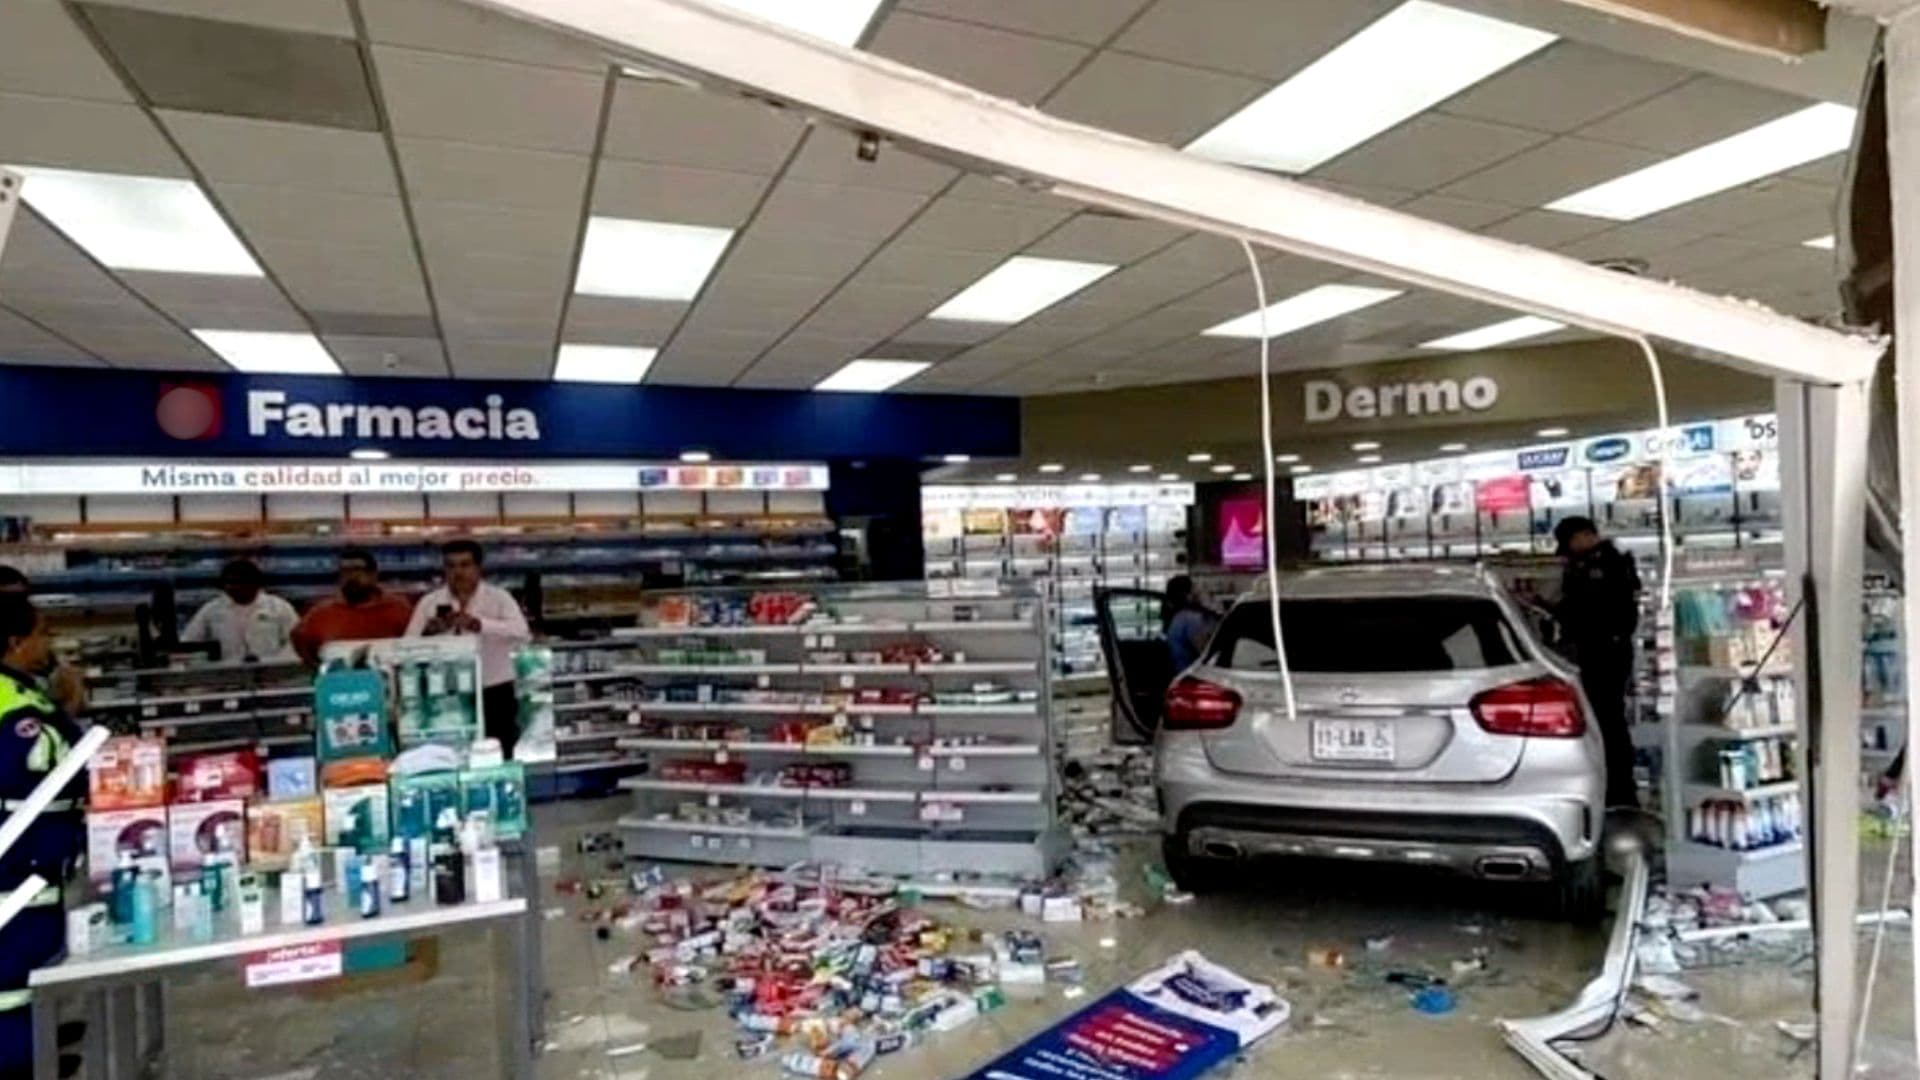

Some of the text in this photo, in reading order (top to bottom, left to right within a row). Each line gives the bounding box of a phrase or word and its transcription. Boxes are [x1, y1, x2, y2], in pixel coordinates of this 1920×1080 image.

[248, 390, 539, 440] Farmacia
[1304, 376, 1499, 422] Dermo
[141, 466, 540, 490] Misma calidad al mejor precio.
